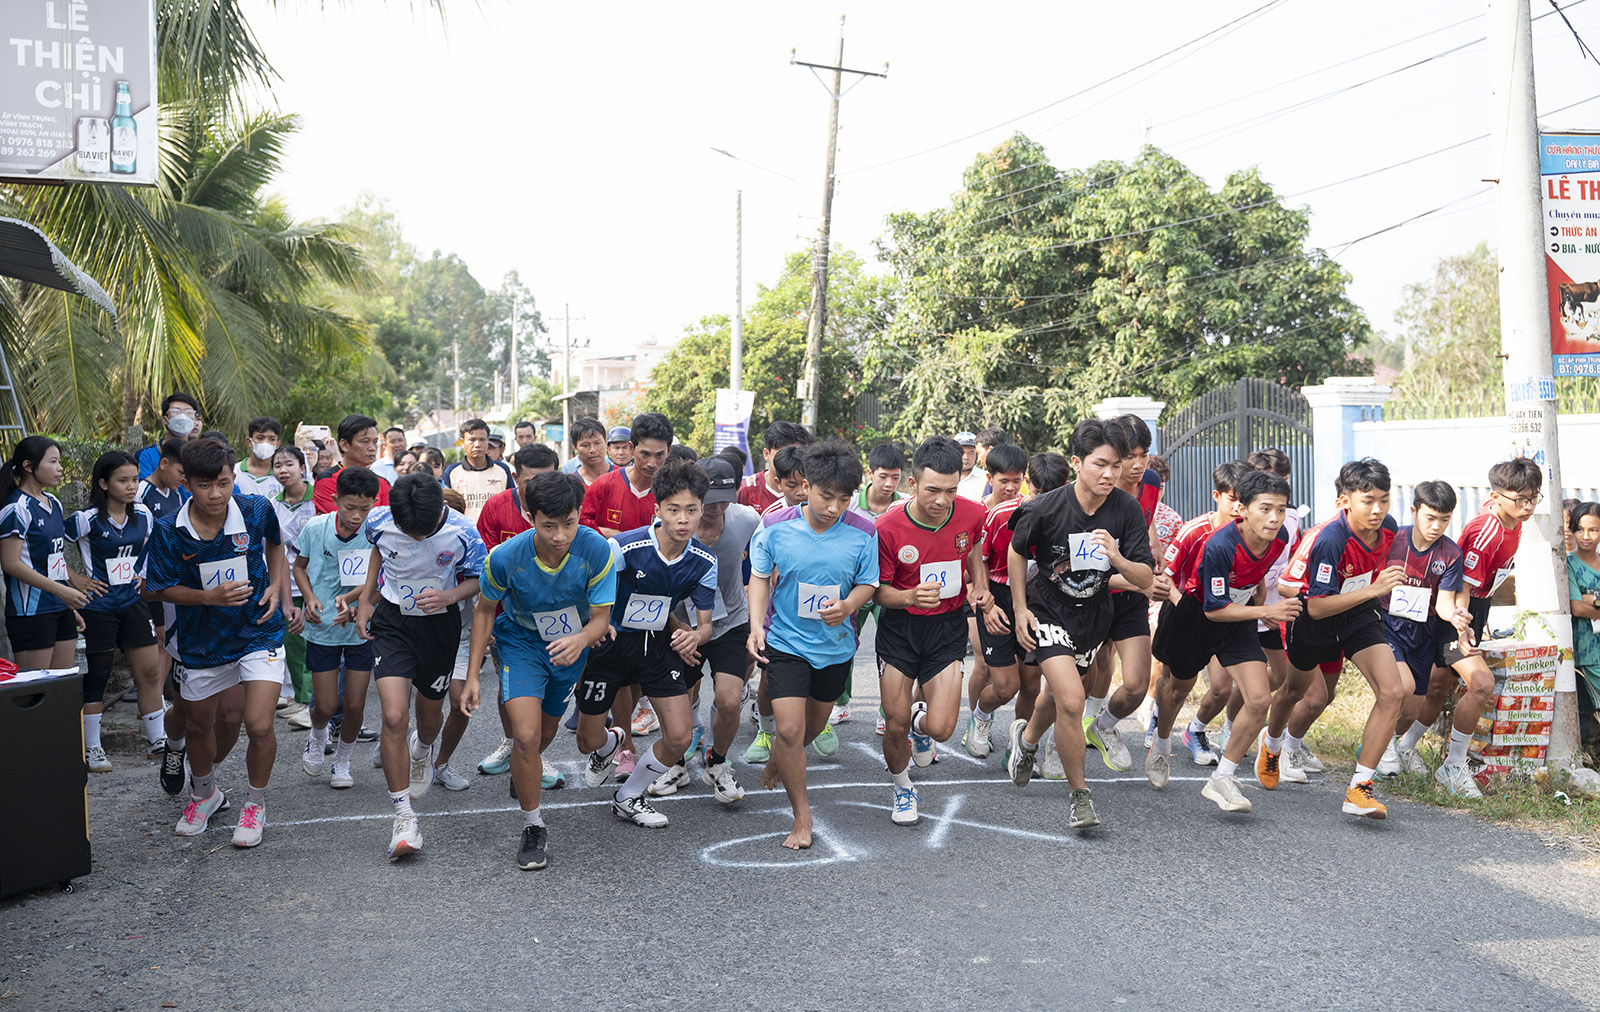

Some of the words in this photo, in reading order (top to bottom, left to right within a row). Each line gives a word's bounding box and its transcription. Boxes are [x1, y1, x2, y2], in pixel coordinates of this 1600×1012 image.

[46, 0, 90, 32] LÊ
[8, 136, 33, 147] 0976
[35, 138, 54, 148] 818
[15, 147, 35, 157] 262
[37, 148, 57, 159] 269
[1587, 159, 1600, 169] BIA
[1548, 175, 1571, 200] LÊ
[1549, 209, 1581, 221] Chuyên
[1561, 225, 1583, 237] THỨC
[1562, 243, 1577, 254] BIA
[1559, 364, 1572, 374] ĐT:
[1075, 539, 1104, 561] 42
[111, 562, 131, 580] 19
[342, 556, 367, 576] 02
[206, 568, 235, 586] 19
[627, 599, 664, 623] 29
[1395, 589, 1423, 618] 34
[539, 612, 573, 636] 28
[1514, 659, 1555, 672] Heineken
[583, 680, 607, 702] 73
[1507, 710, 1543, 720] Heineken
[1502, 734, 1538, 744] Heineken
